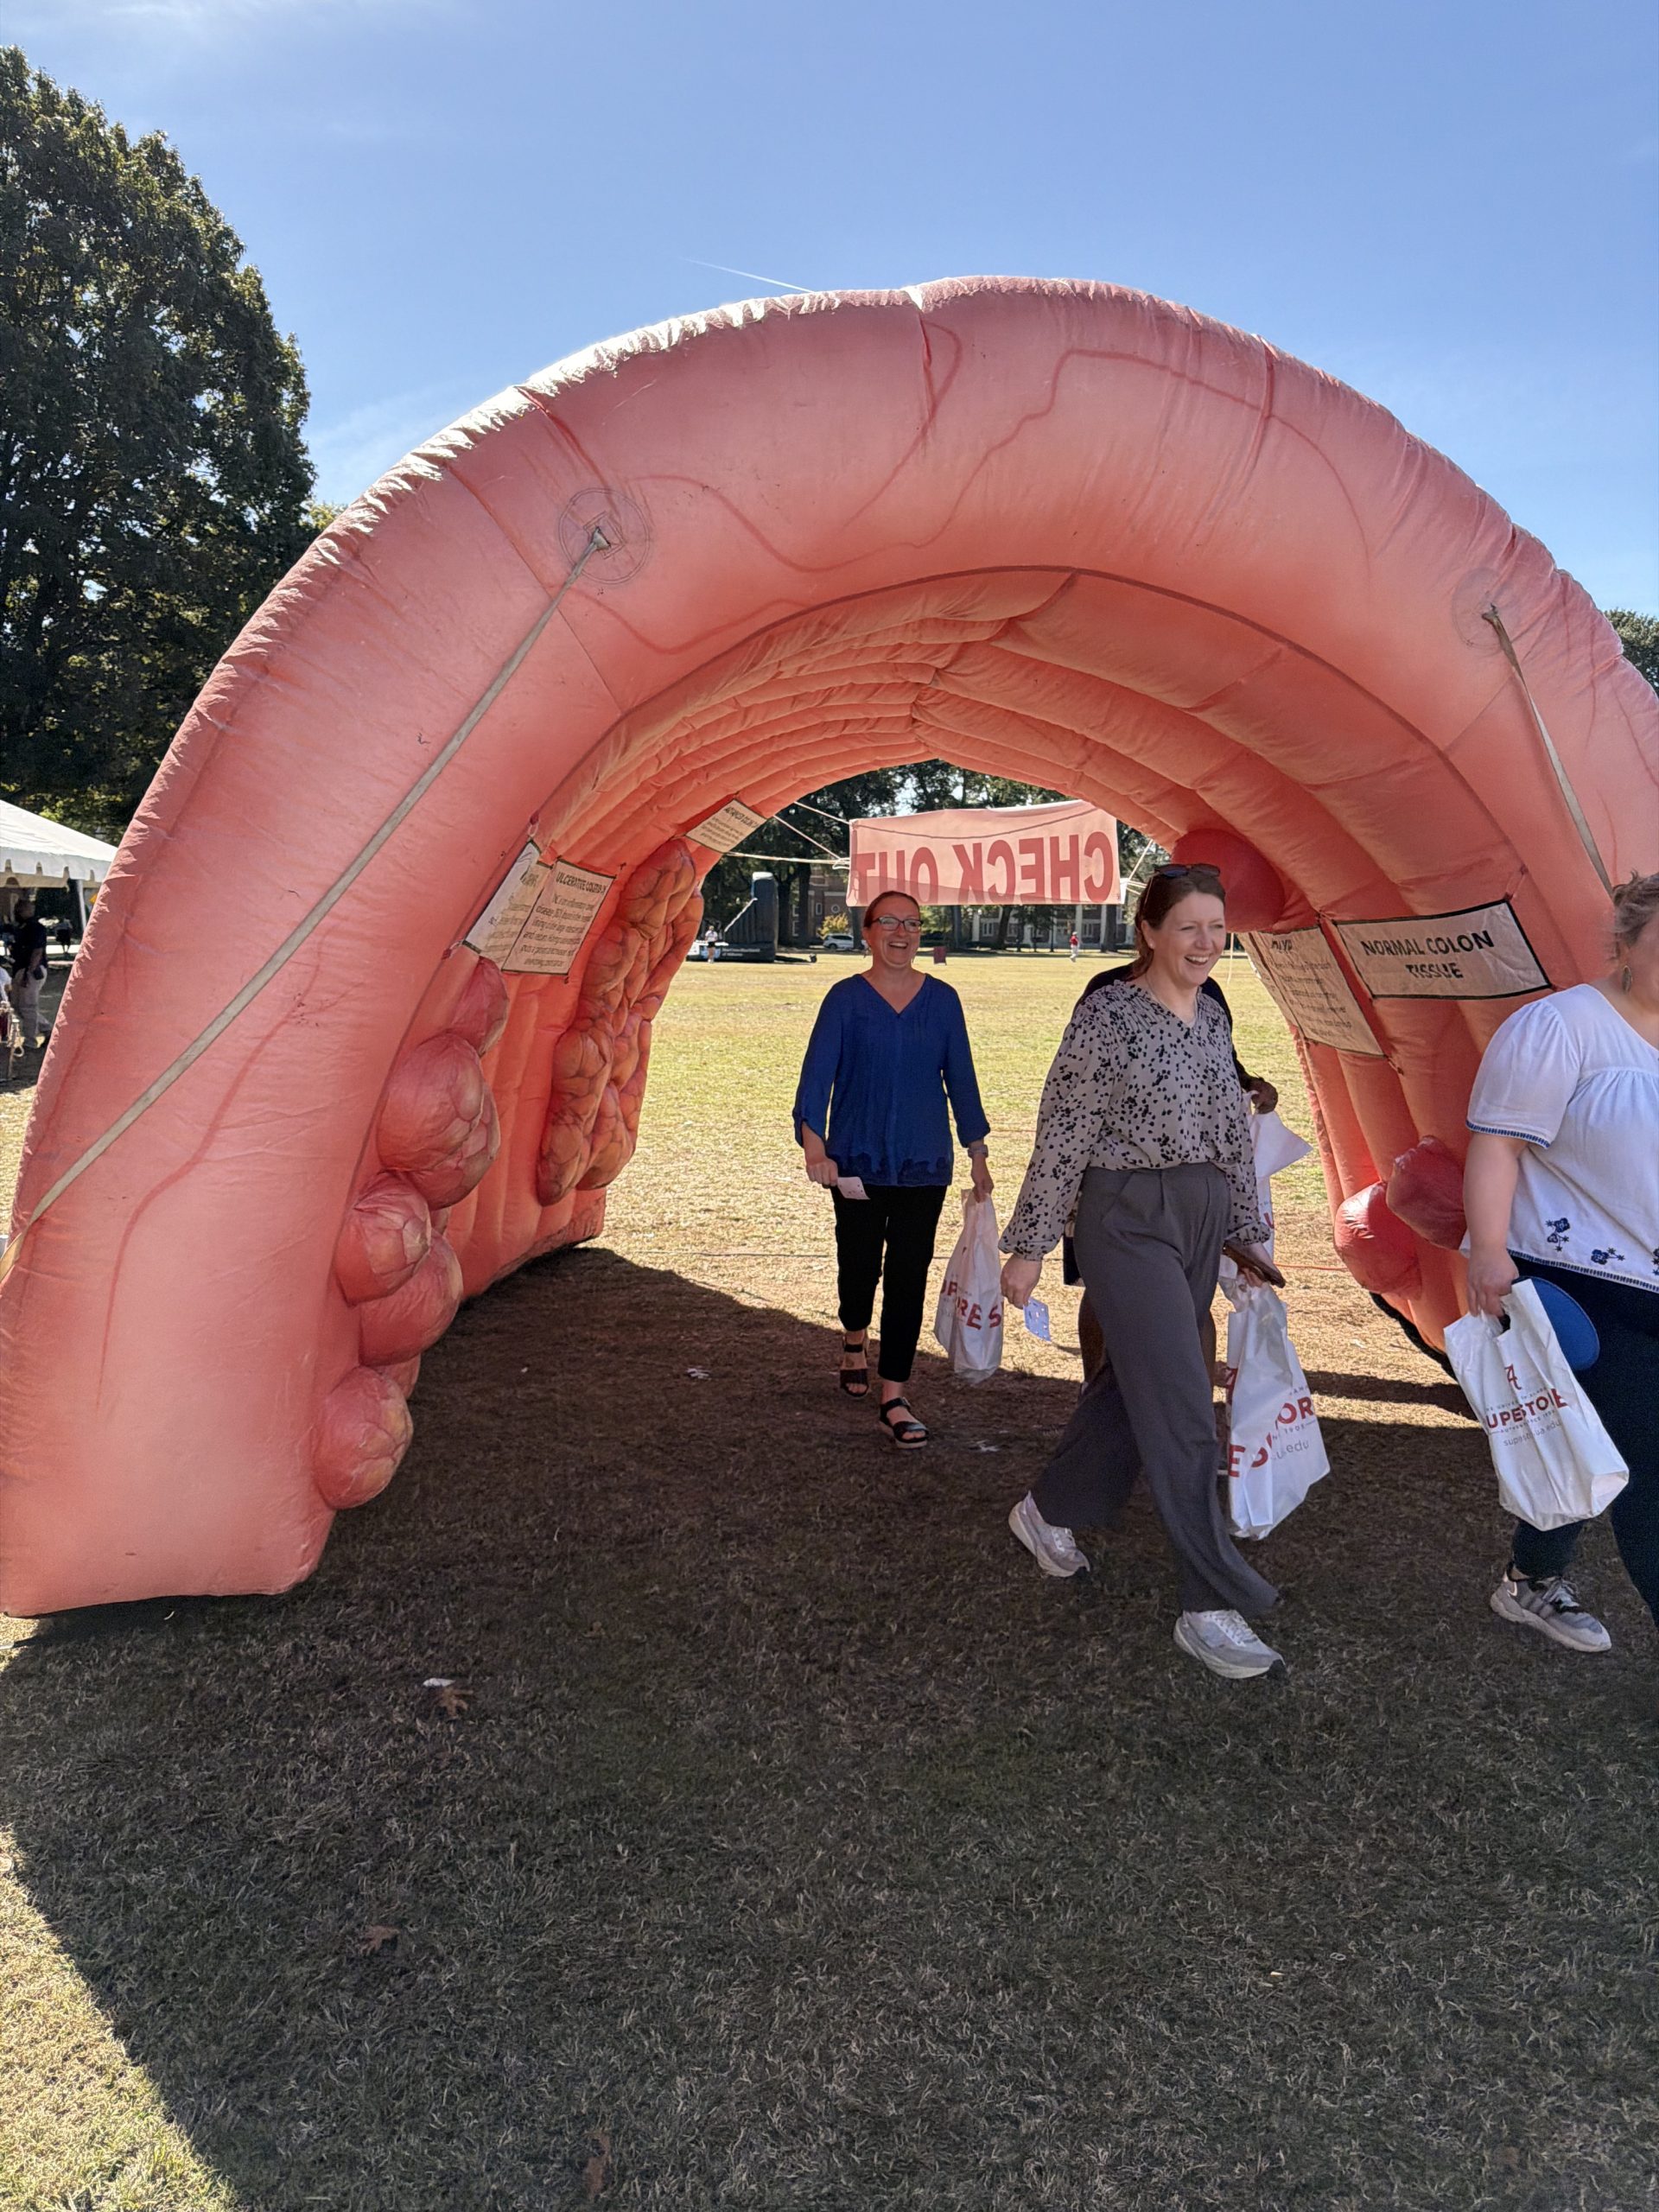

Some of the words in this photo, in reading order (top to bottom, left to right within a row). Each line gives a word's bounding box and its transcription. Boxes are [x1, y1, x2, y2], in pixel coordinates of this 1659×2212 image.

[1361, 938, 1425, 957] NORMAL
[1426, 930, 1494, 955] COLON
[1405, 962, 1464, 979] TISSUE
